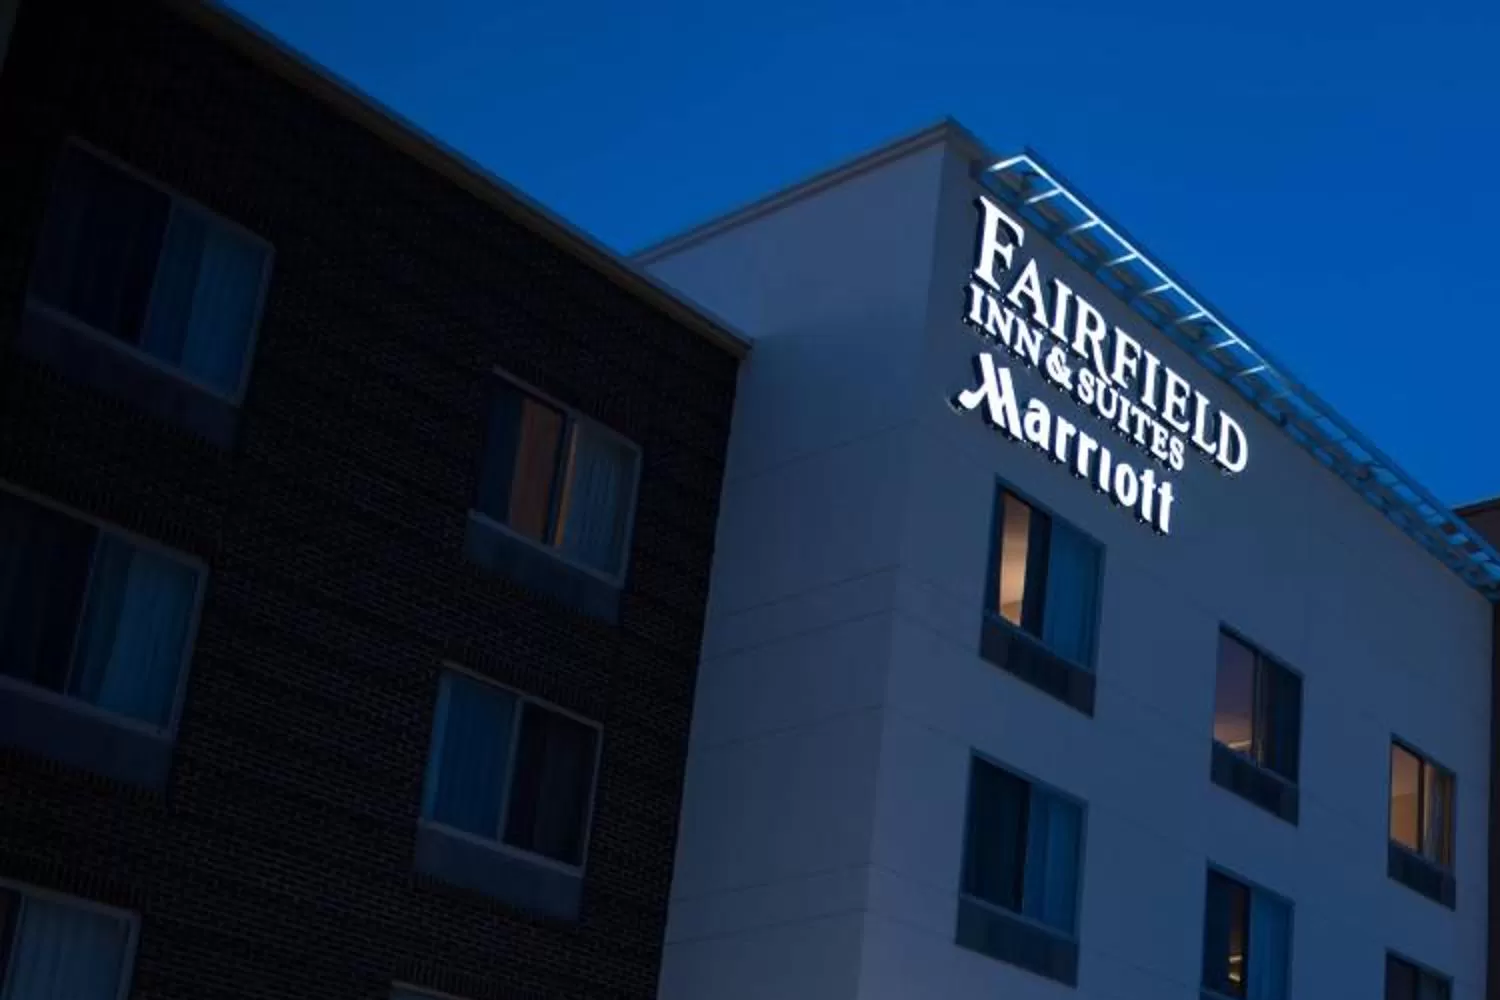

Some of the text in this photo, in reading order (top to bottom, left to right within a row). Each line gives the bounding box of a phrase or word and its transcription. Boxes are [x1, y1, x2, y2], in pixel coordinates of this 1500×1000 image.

[968, 283, 1185, 472] INN & SUITES
[974, 195, 1249, 473] FAIRFIELD
[957, 352, 1175, 534] Marriott
